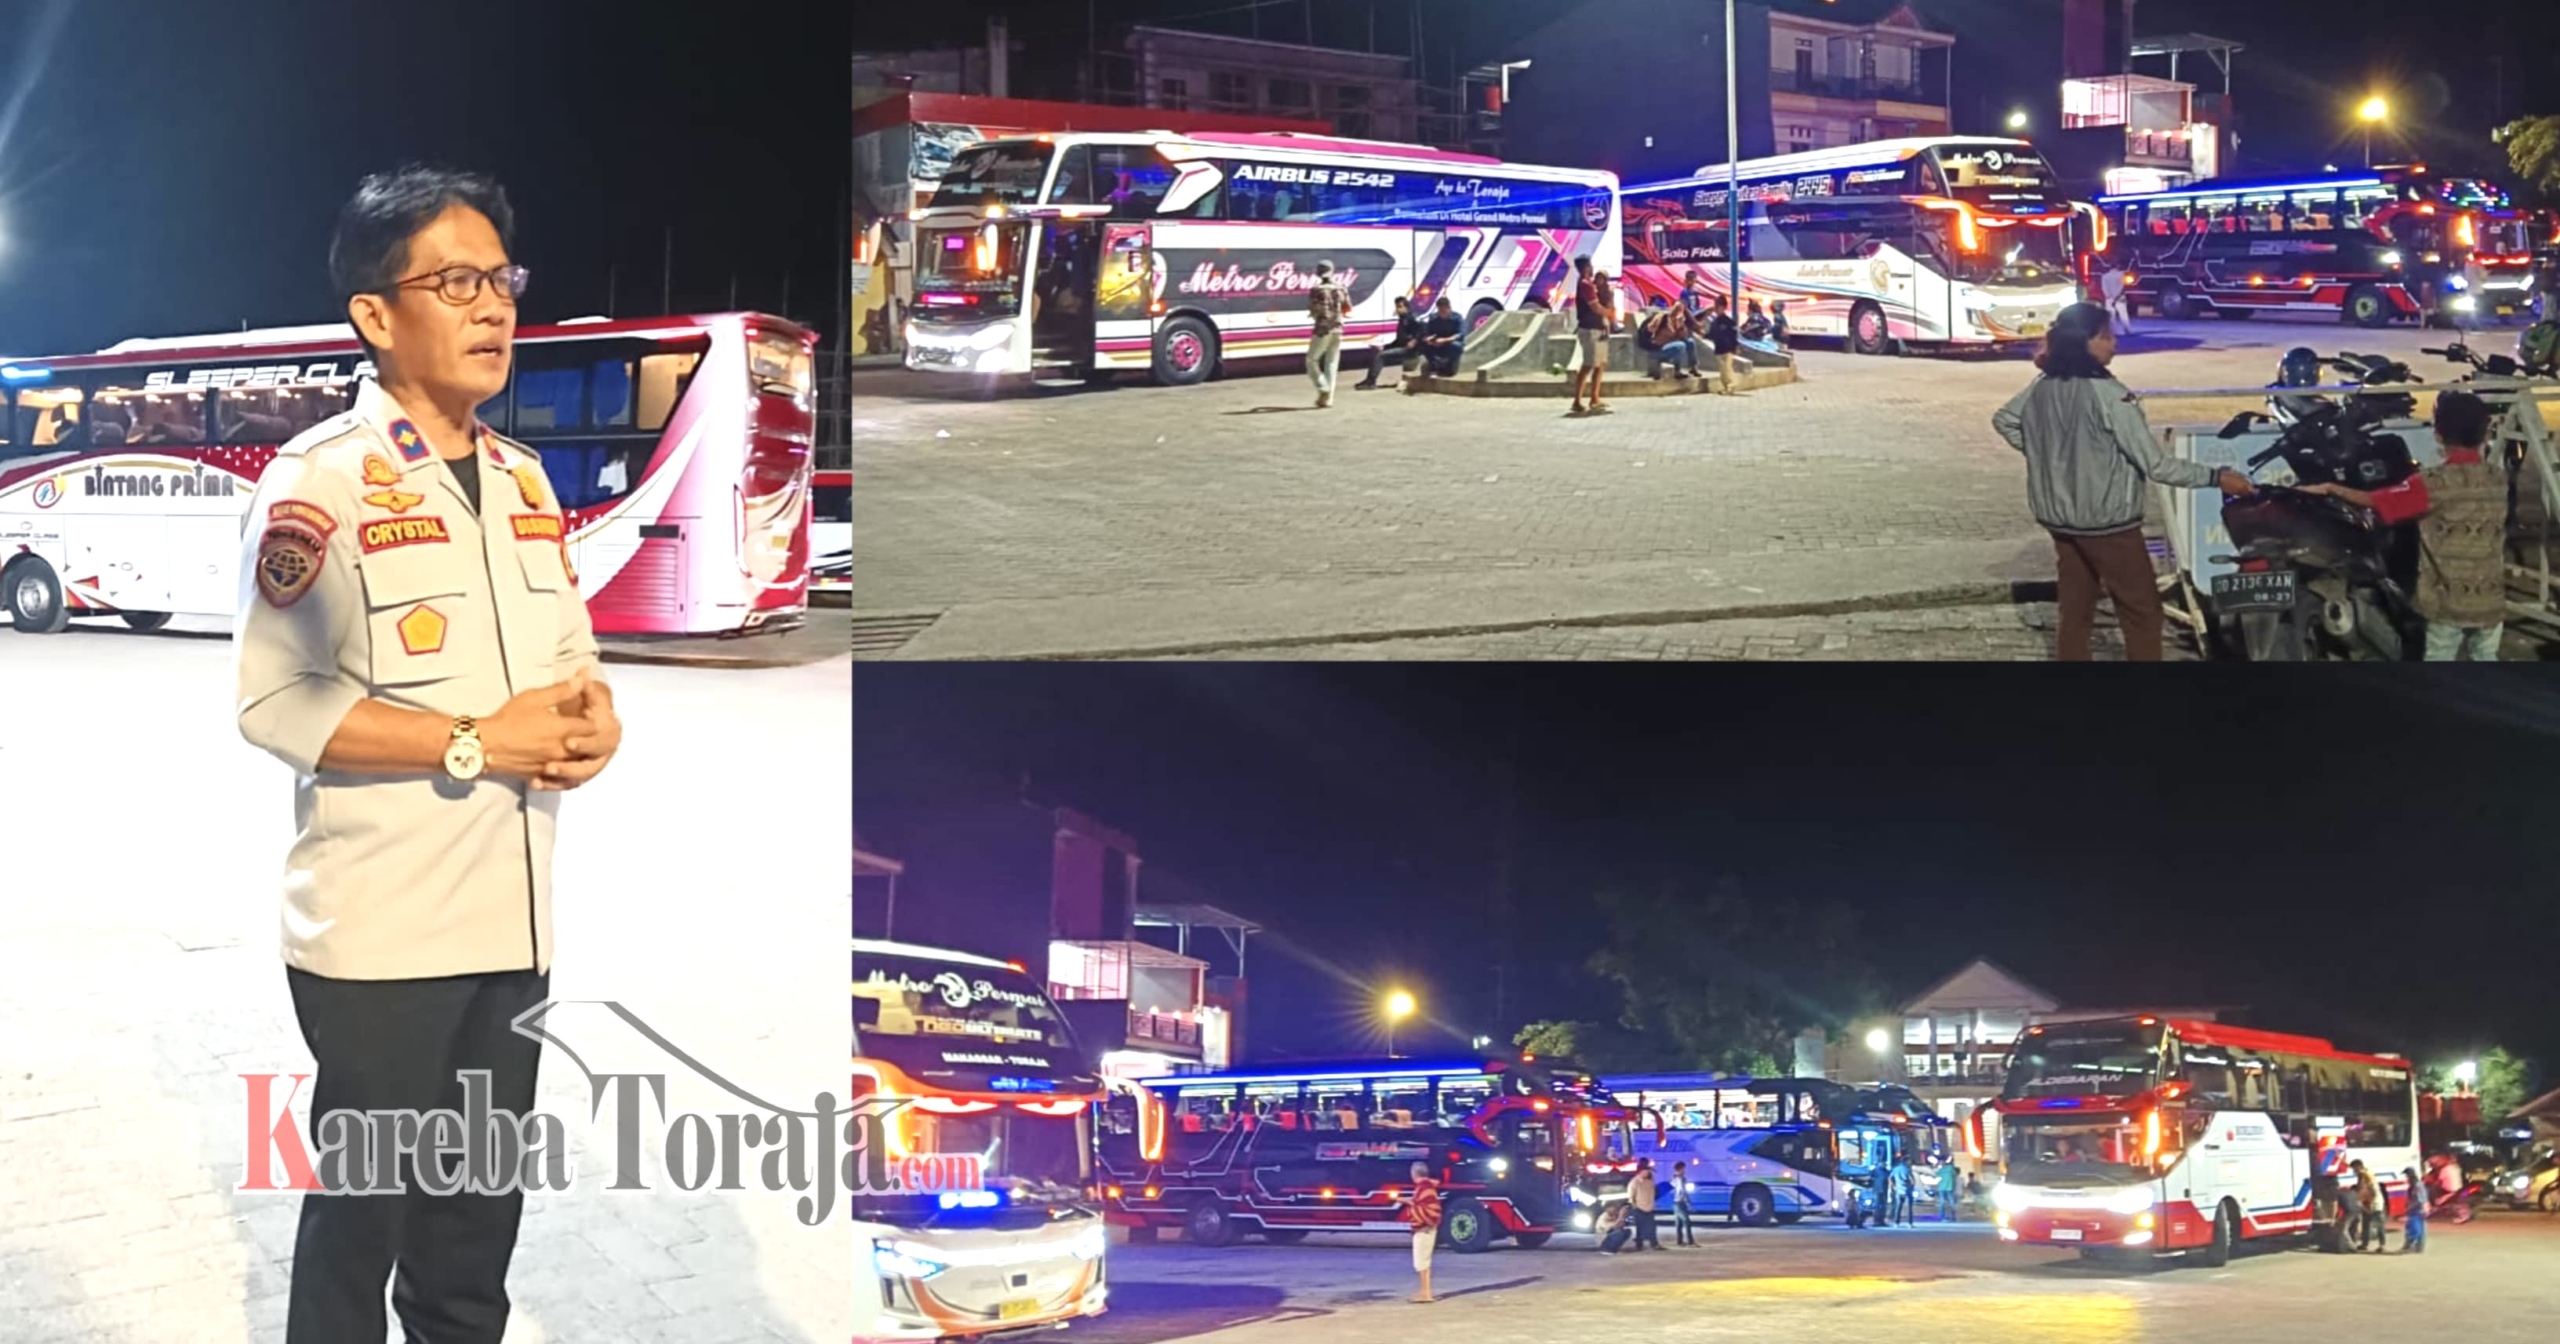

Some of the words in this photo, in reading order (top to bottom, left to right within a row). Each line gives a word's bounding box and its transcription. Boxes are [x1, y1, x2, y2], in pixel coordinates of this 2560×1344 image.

[1233, 165, 1330, 184] AIRBUS
[1333, 171, 1395, 188] 2542
[1474, 211, 1499, 222] Grand
[1499, 213, 1521, 223] Metro
[1179, 262, 1264, 293] Metro
[1266, 261, 1360, 290] Perai
[146, 365, 300, 392] SLEEPER
[85, 468, 164, 497] BINTANG
[171, 467, 234, 497] PRIMA
[365, 518, 448, 545] CRYSTAL
[2266, 574, 2292, 588] XAN
[967, 980, 1047, 1008] Permai
